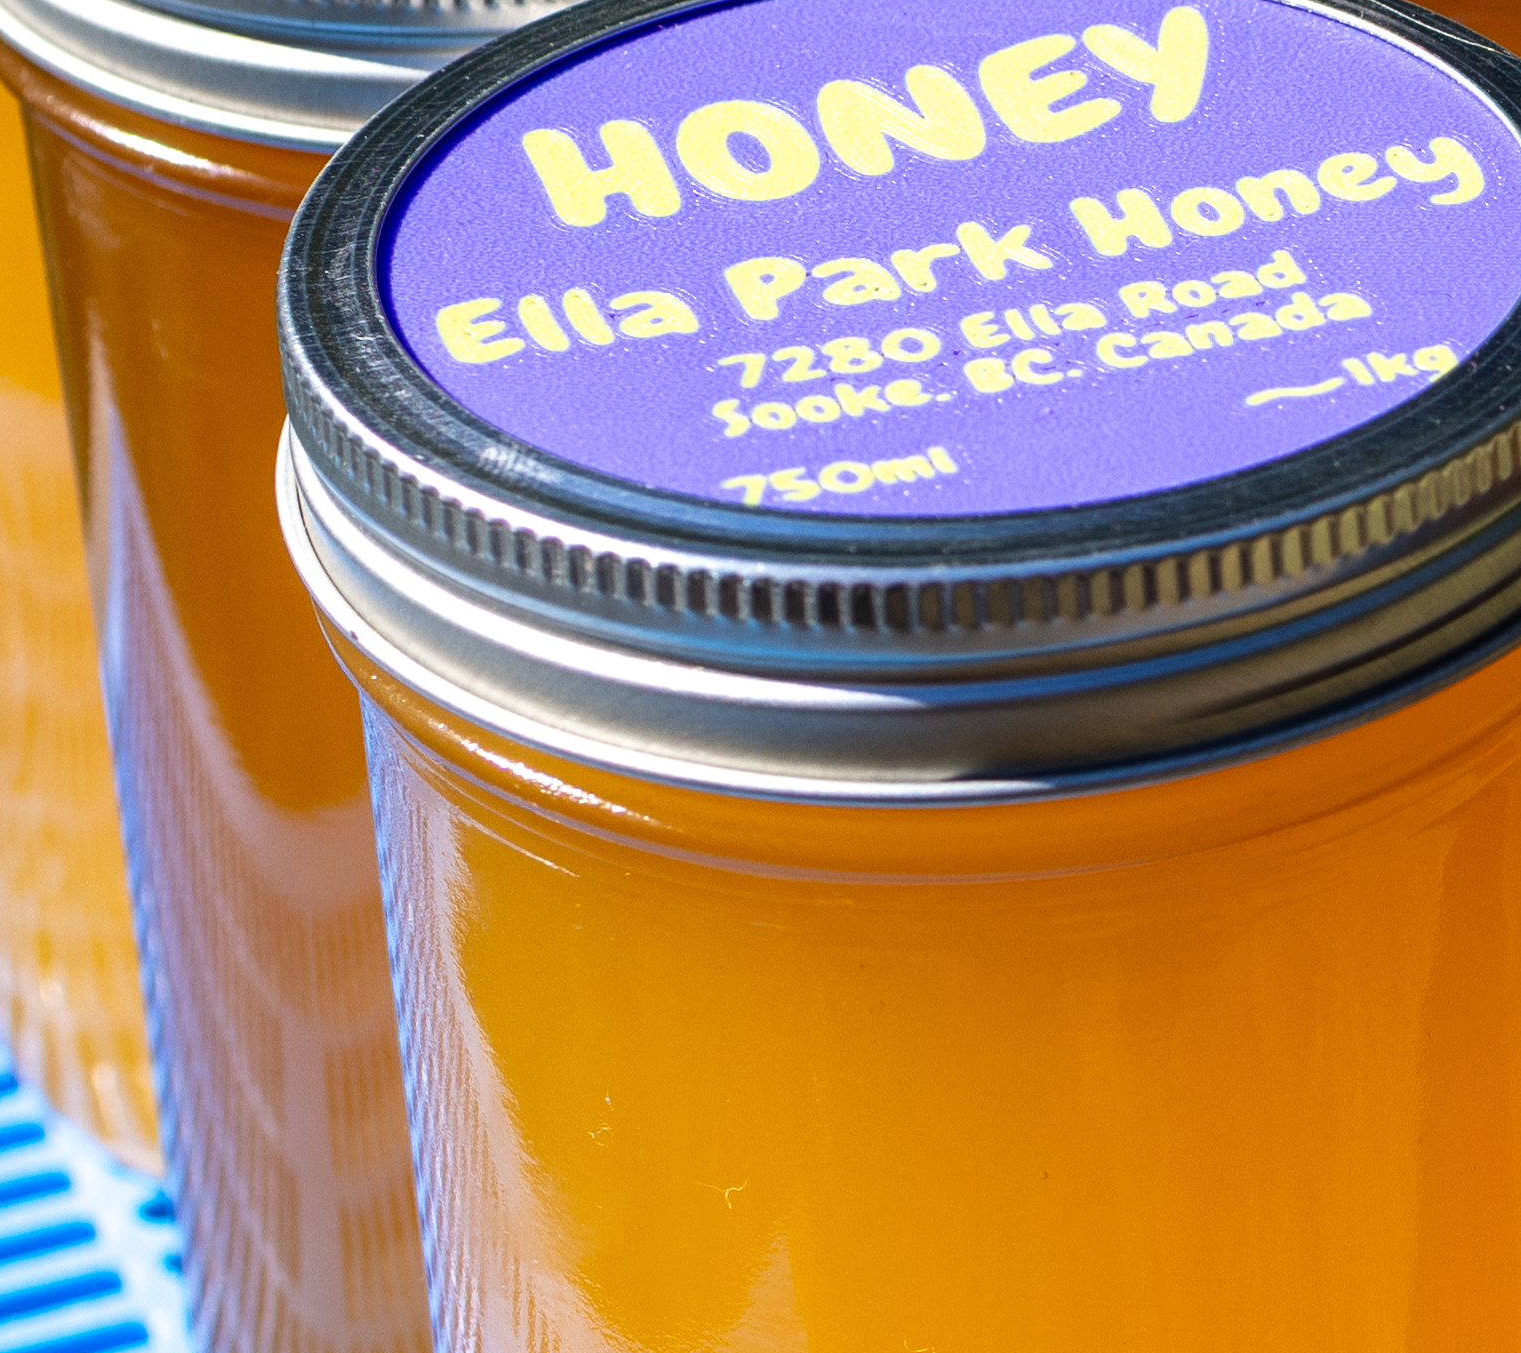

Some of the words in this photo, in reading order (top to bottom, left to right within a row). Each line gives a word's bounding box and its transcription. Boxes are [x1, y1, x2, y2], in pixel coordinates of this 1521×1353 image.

[523, 7, 1208, 227] HONEY
[436, 288, 698, 363] Ella
[725, 222, 1047, 320] Park
[1071, 138, 1484, 255] Honey
[720, 329, 940, 387] 7280
[961, 304, 1105, 348] Ella
[1124, 251, 1308, 317] Road
[1099, 293, 1371, 368] Canada
[724, 448, 955, 506] 750ml
